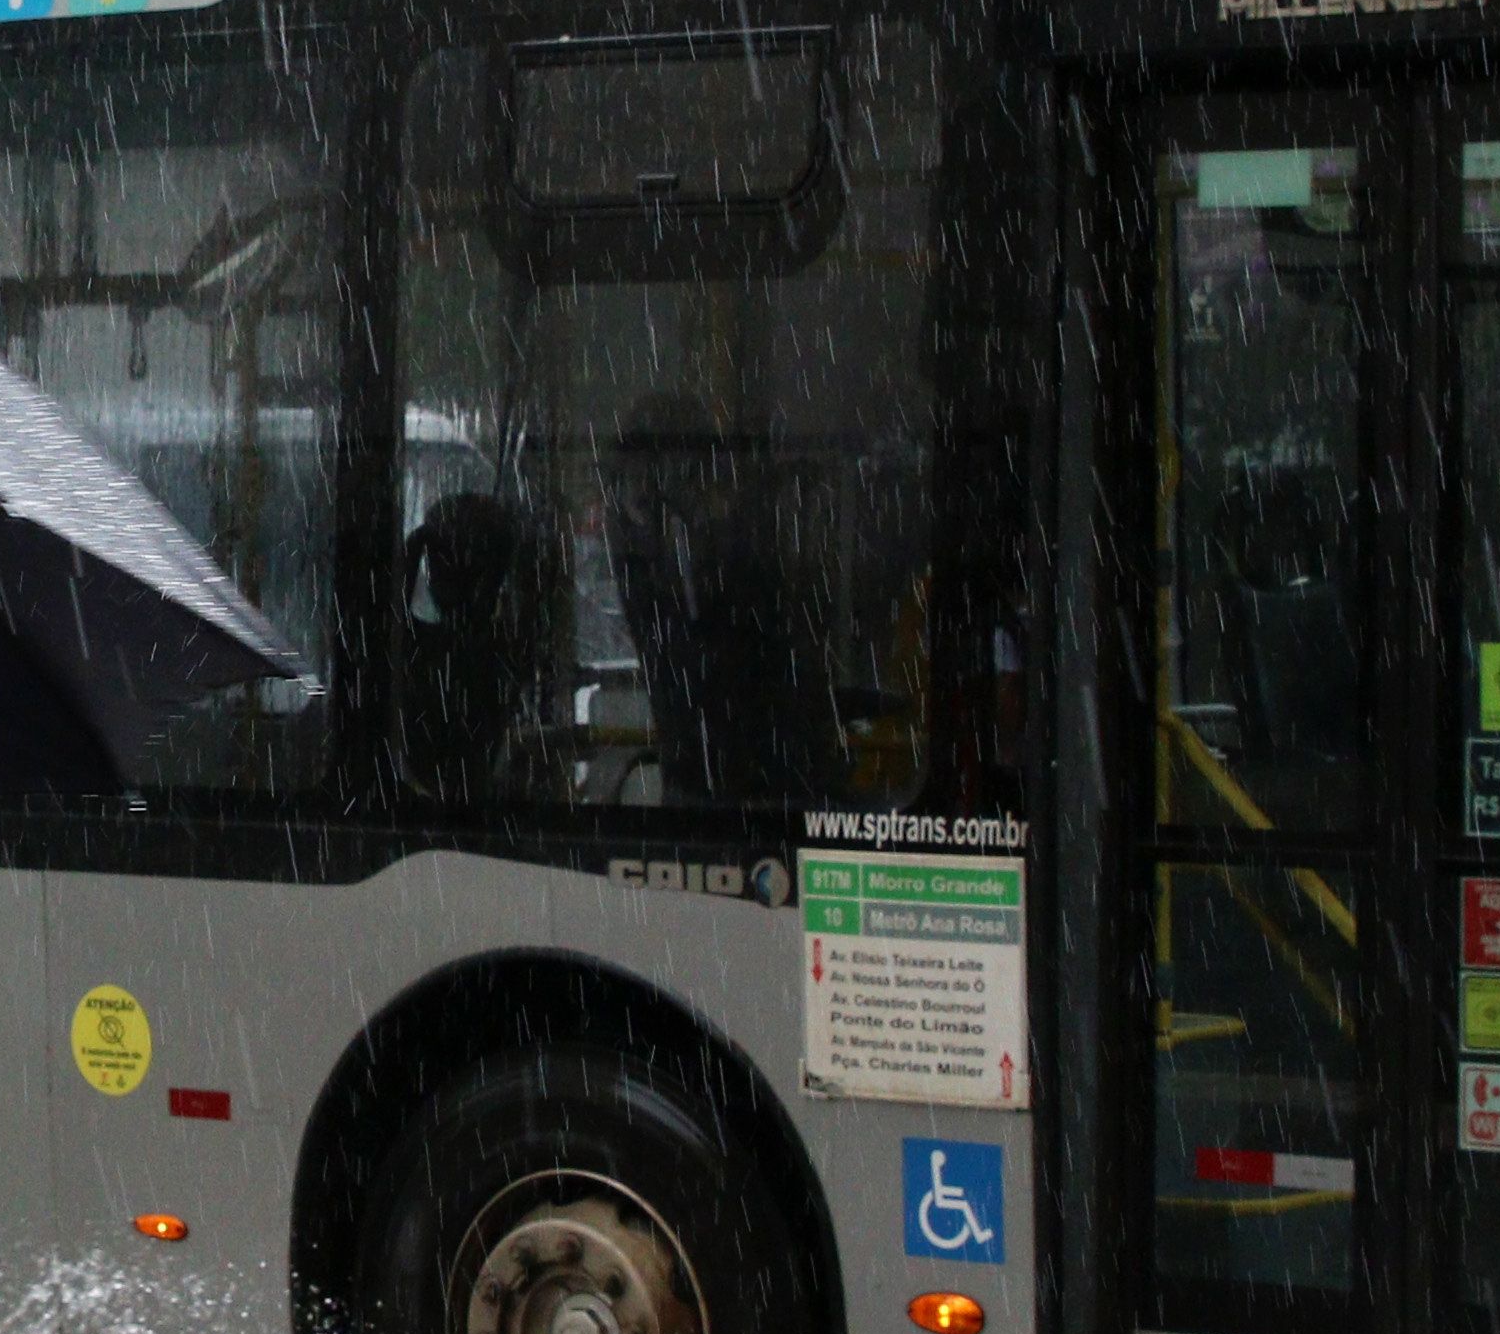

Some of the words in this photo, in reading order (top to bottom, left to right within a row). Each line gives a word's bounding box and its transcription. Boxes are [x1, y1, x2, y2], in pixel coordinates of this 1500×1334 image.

[804, 807, 1029, 848] www.sptrans.com.br
[868, 870, 926, 893] Morro
[931, 874, 1005, 896] Grande
[921, 913, 955, 932] Ana
[958, 915, 1007, 935] Rosa
[892, 953, 944, 969] Teixeira
[949, 957, 984, 971] Leite
[852, 972, 890, 987] Nossa
[894, 975, 949, 991] Senhora
[952, 979, 970, 992] do
[854, 993, 918, 1010] Celestino
[831, 1011, 884, 1026] Ponte
[890, 1016, 914, 1030] do
[921, 1019, 984, 1035] Limão
[942, 1042, 985, 1057] Vicente
[868, 1056, 932, 1074] Charles
[937, 1062, 984, 1077] Miller
